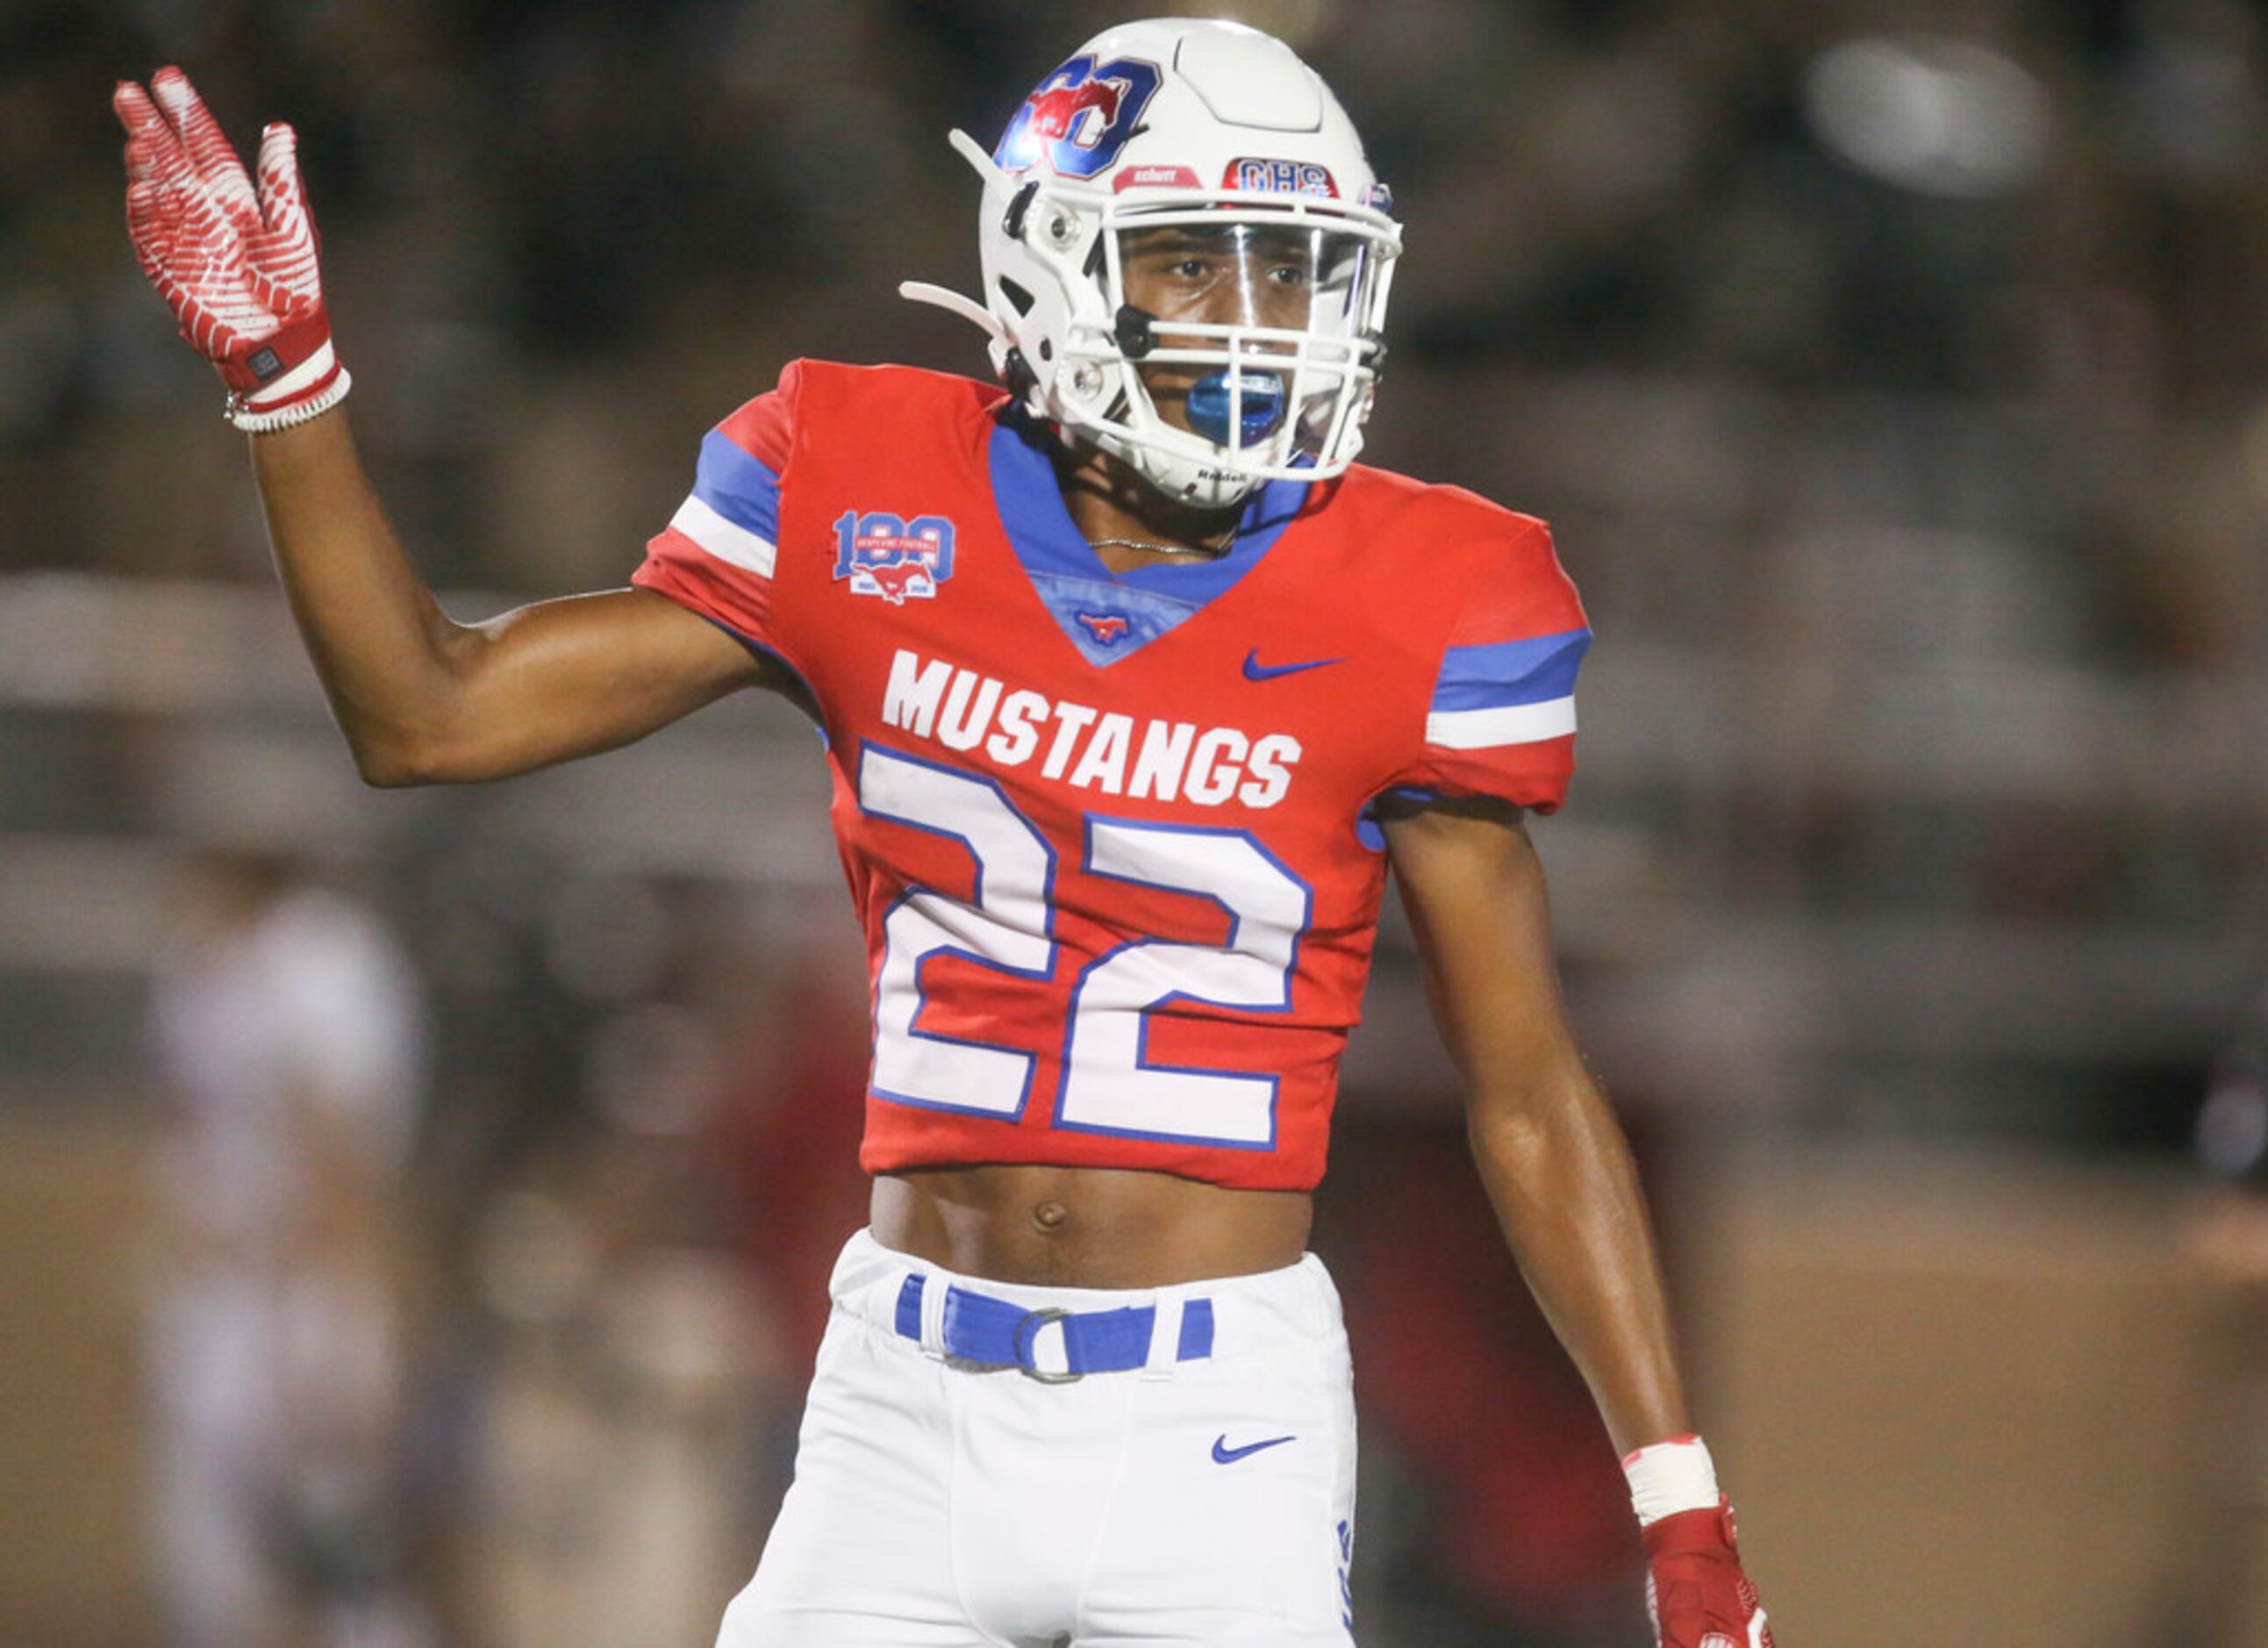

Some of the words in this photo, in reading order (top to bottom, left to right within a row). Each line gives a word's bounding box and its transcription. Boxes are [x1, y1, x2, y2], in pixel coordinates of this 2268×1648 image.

[1133, 168, 1177, 183] schutt
[1237, 159, 1326, 197] GHS
[882, 648, 1302, 809] MUSTANGS
[856, 738, 1313, 1151] 22
